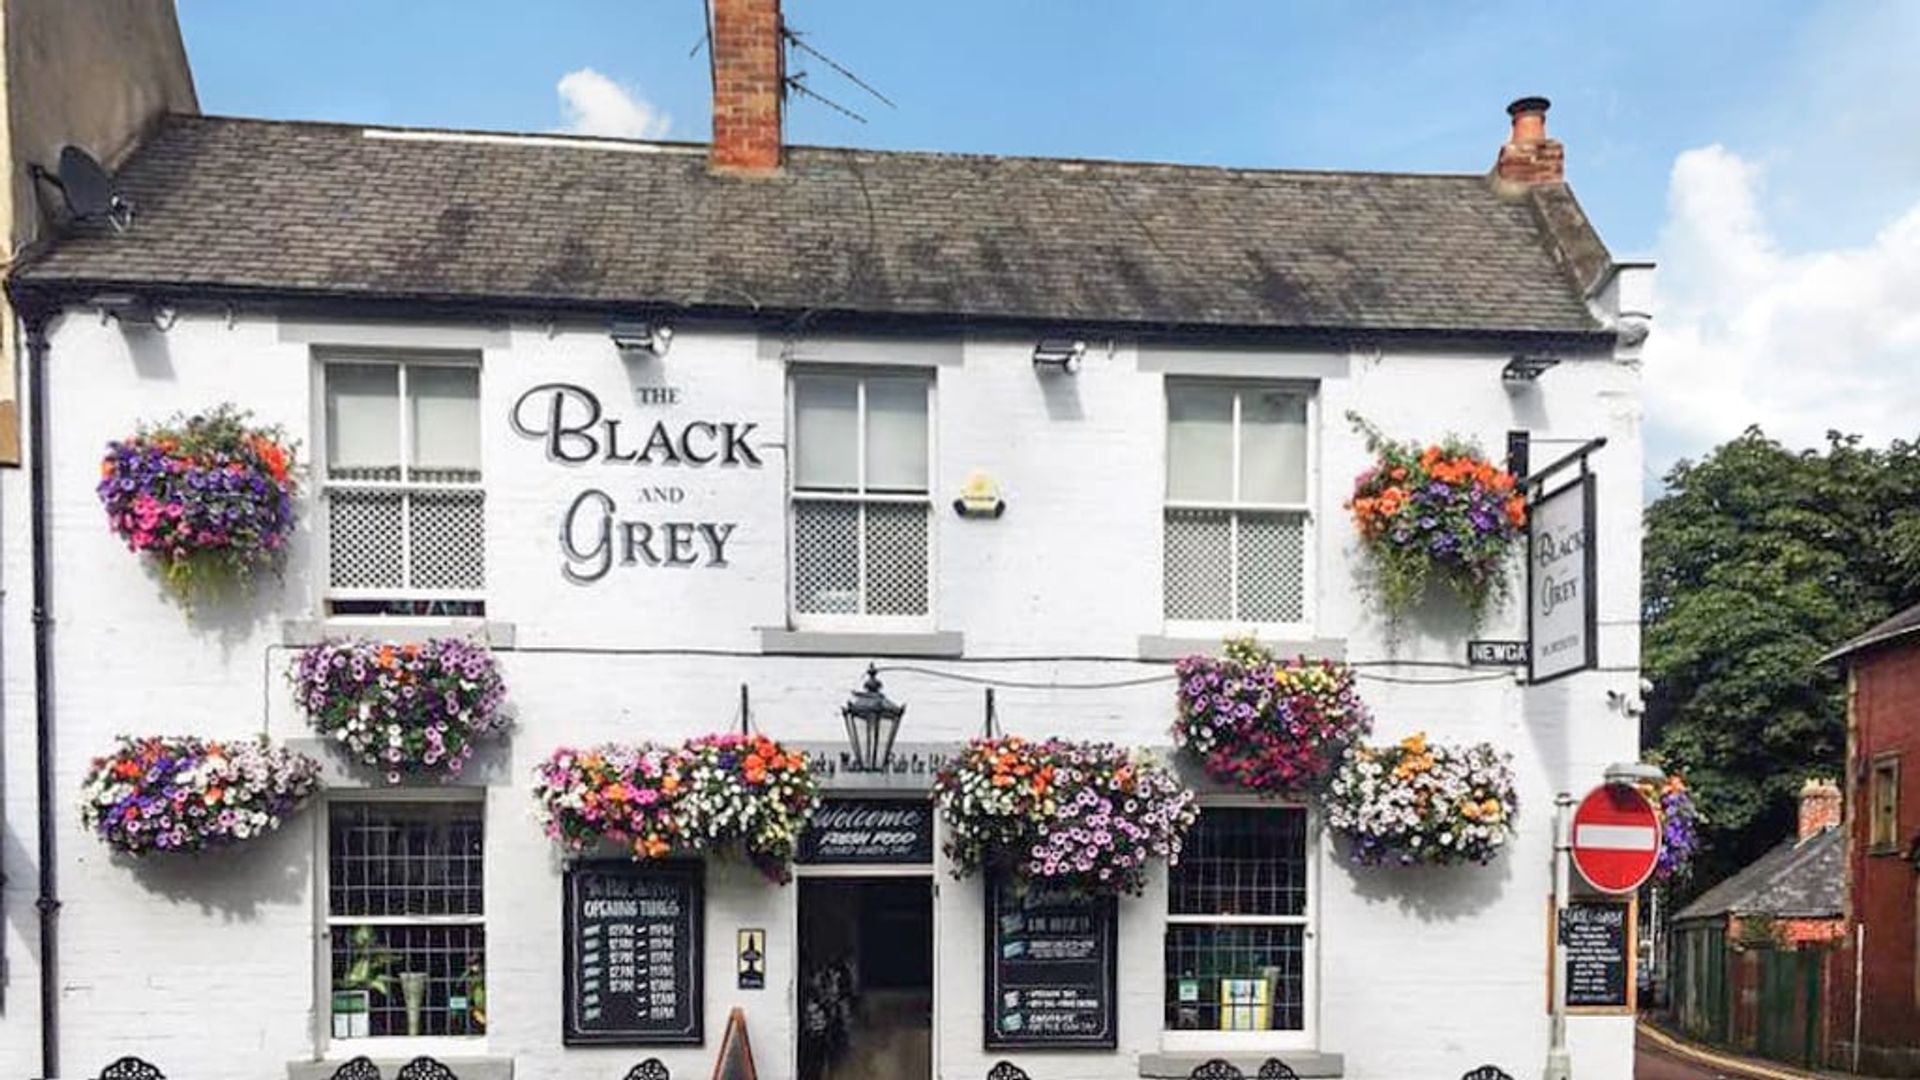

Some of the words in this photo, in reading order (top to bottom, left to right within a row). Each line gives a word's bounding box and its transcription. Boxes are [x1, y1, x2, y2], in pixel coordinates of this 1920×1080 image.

[637, 387, 680, 405] THE
[509, 382, 763, 469] BLACK
[637, 486, 685, 503] AND
[559, 488, 736, 586] GREY
